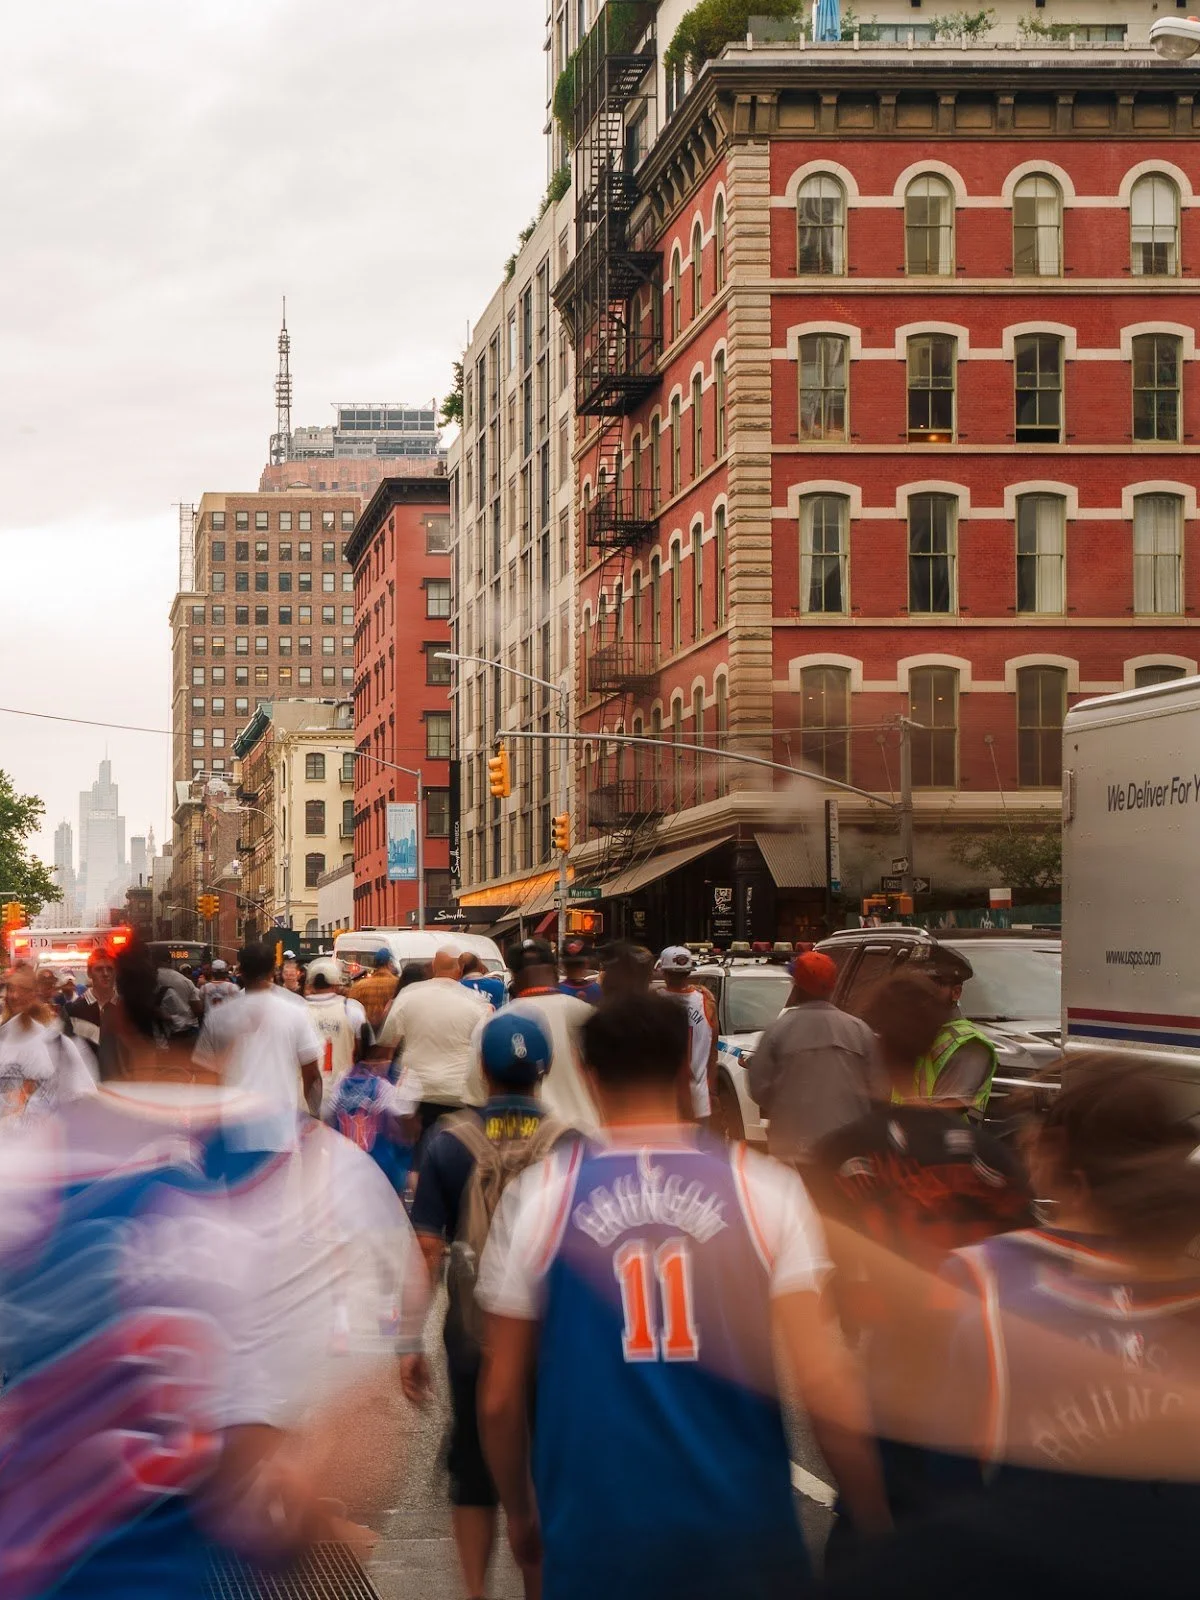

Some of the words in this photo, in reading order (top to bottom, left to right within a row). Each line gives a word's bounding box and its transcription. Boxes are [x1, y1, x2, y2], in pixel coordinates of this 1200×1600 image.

[1107, 784, 1125, 812] We
[1127, 780, 1169, 810] Deliver
[1170, 776, 1191, 805] For
[571, 889, 592, 897] Warren
[434, 908, 466, 920] Smyth
[1106, 950, 1161, 968] www.usps.com
[613, 1236, 699, 1363] 11
